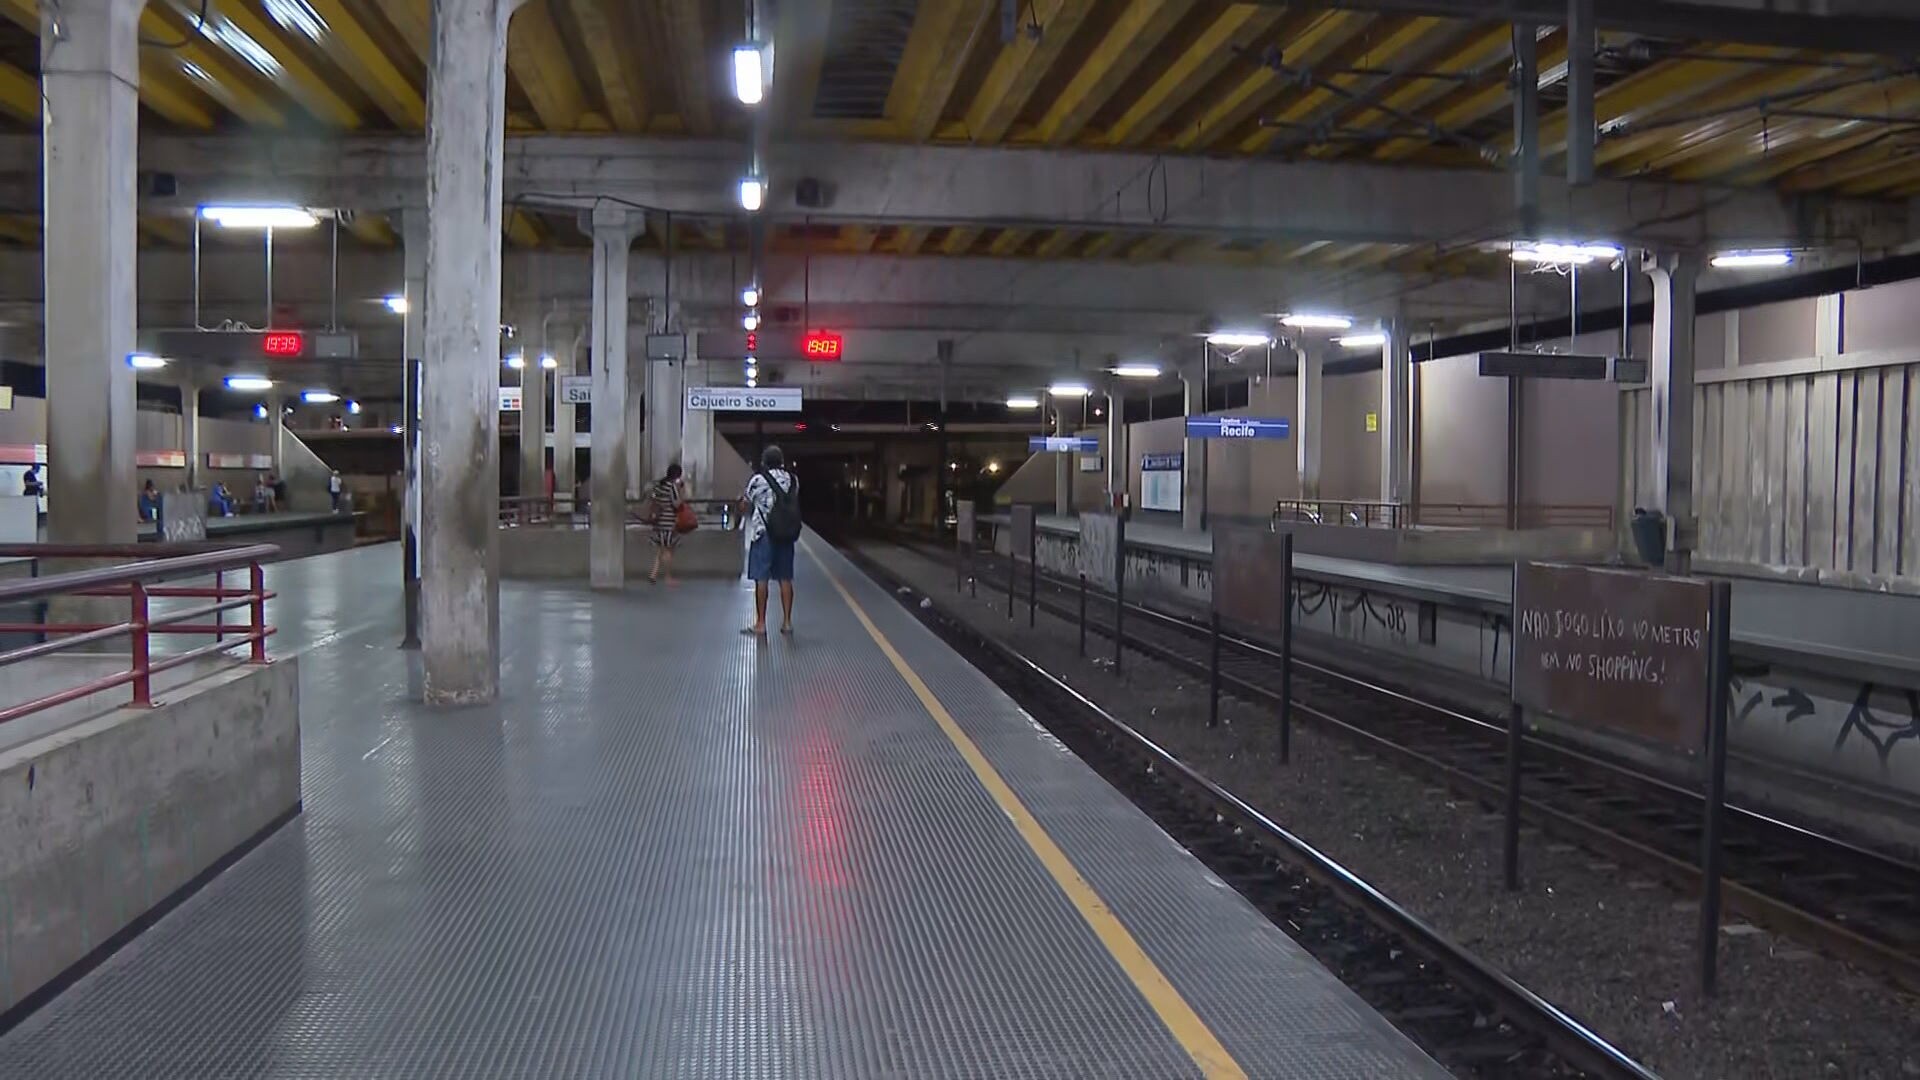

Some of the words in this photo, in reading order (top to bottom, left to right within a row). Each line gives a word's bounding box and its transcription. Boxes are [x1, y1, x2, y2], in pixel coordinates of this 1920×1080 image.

[266, 336, 297, 351] 19:39
[807, 340, 838, 353] 19:03
[690, 395, 741, 408] Cajueiro
[746, 396, 777, 408] Seco
[1220, 425, 1255, 437] Recife
[1566, 652, 1582, 671] NO
